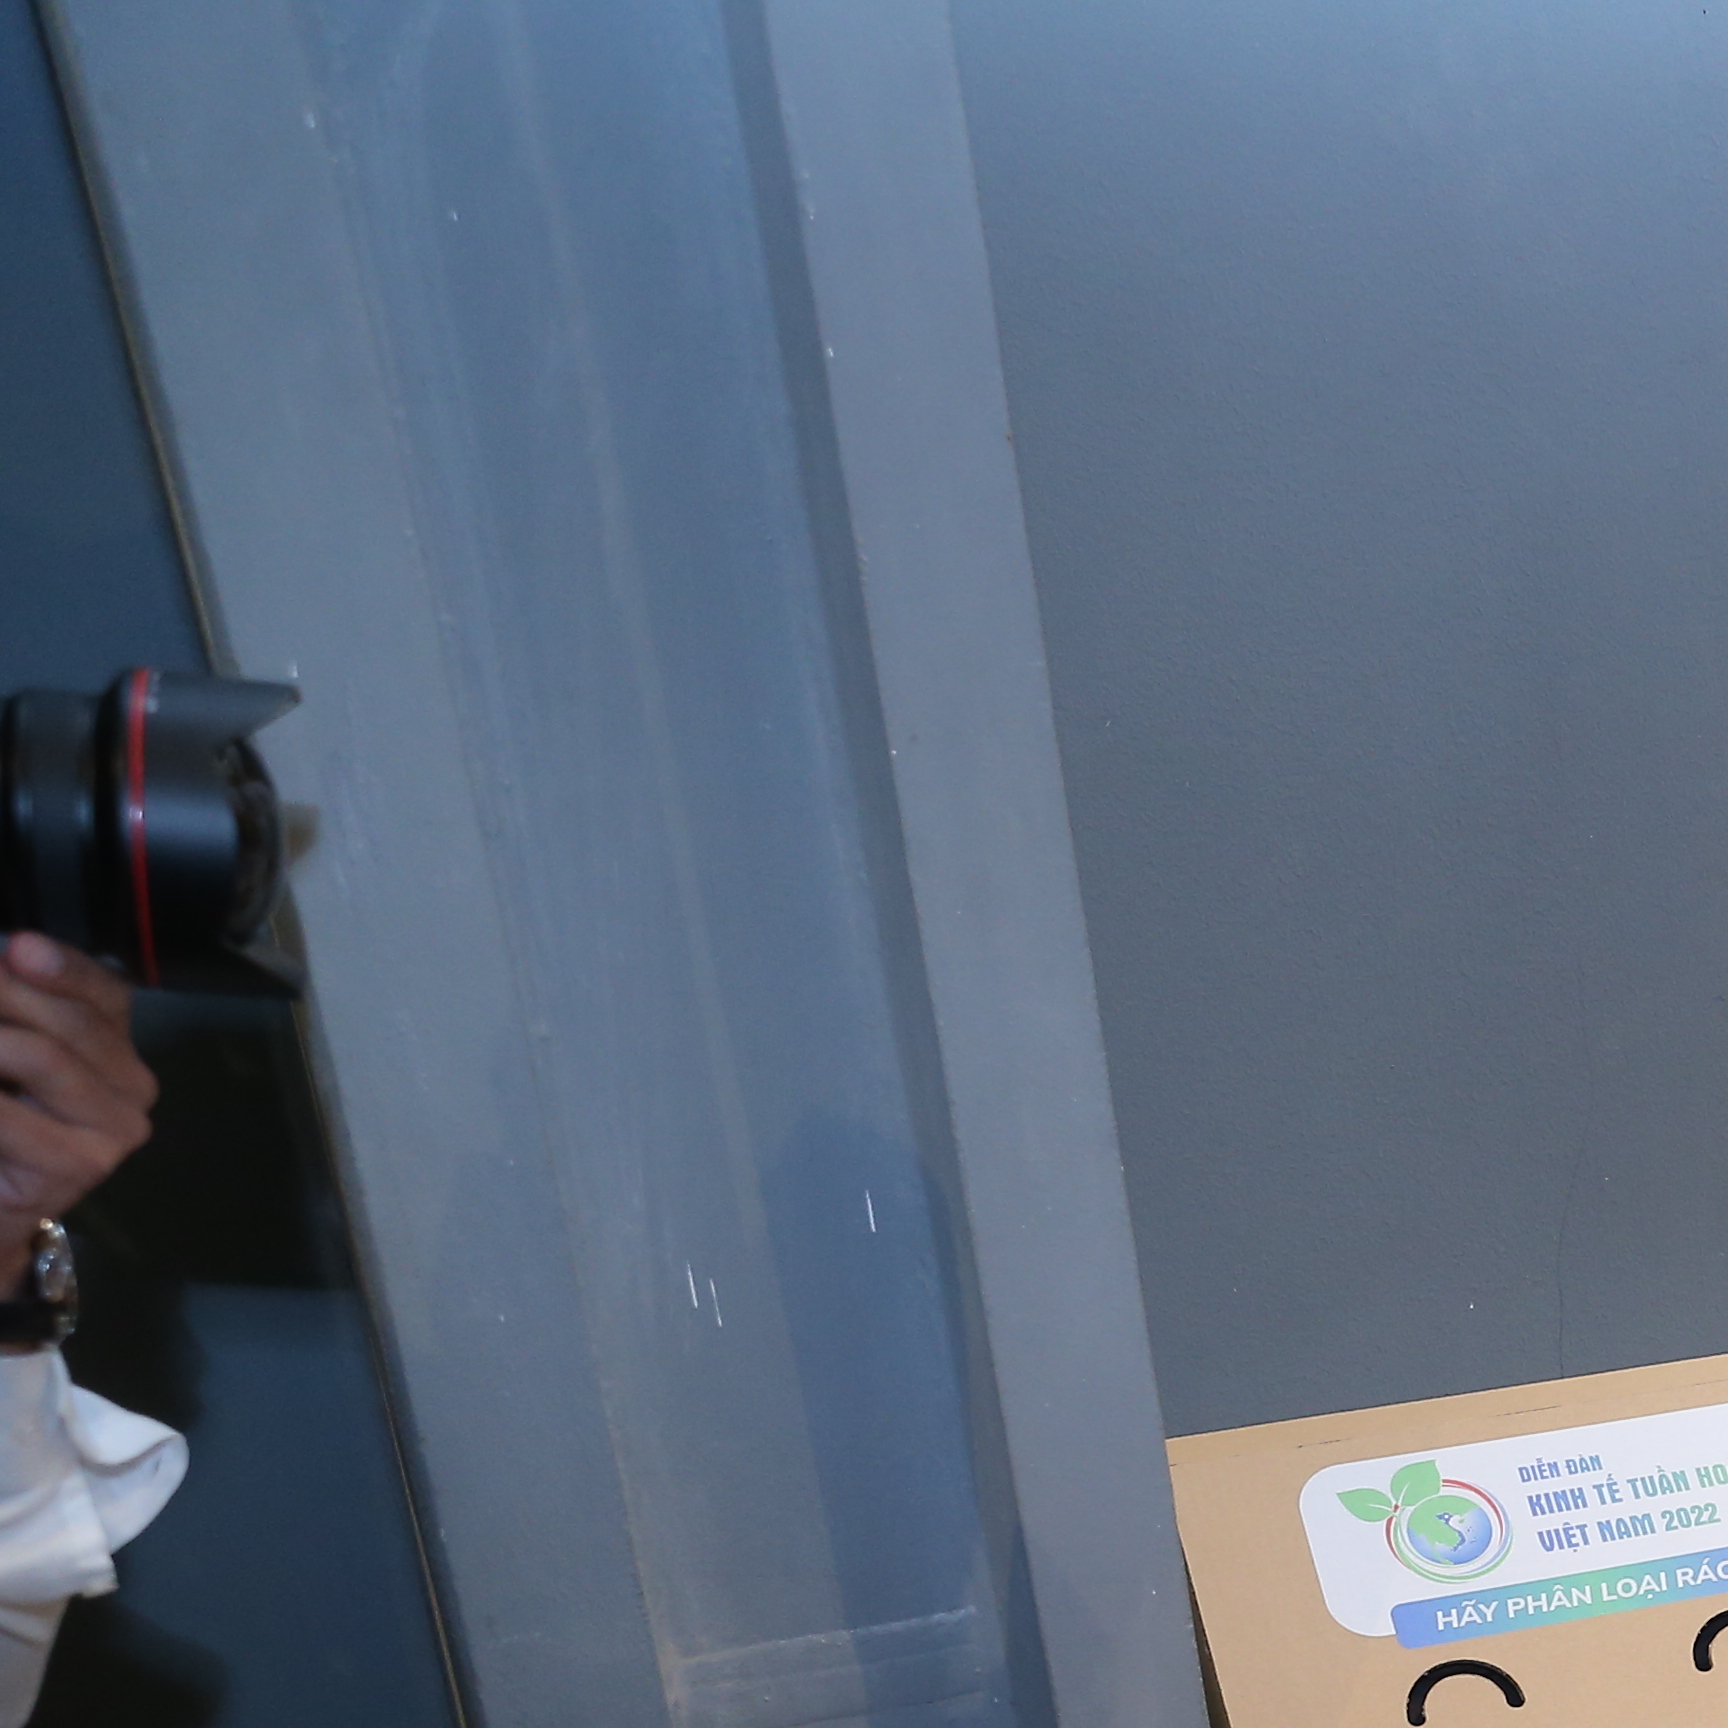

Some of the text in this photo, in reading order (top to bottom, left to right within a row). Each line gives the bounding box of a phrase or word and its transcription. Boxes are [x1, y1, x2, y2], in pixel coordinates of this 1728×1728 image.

[1518, 1454, 1602, 1483] DIỄN ĐÀN
[1527, 1488, 1588, 1516] KINH
[1592, 1473, 1623, 1508] TẾ
[1626, 1465, 1690, 1499] TUẦN
[1537, 1503, 1720, 1552] VIỆT NAM 2022
[1437, 1600, 1498, 1630] HÃY
[1508, 1585, 1592, 1618] PHÂN
[1601, 1572, 1667, 1601] LOẠI
